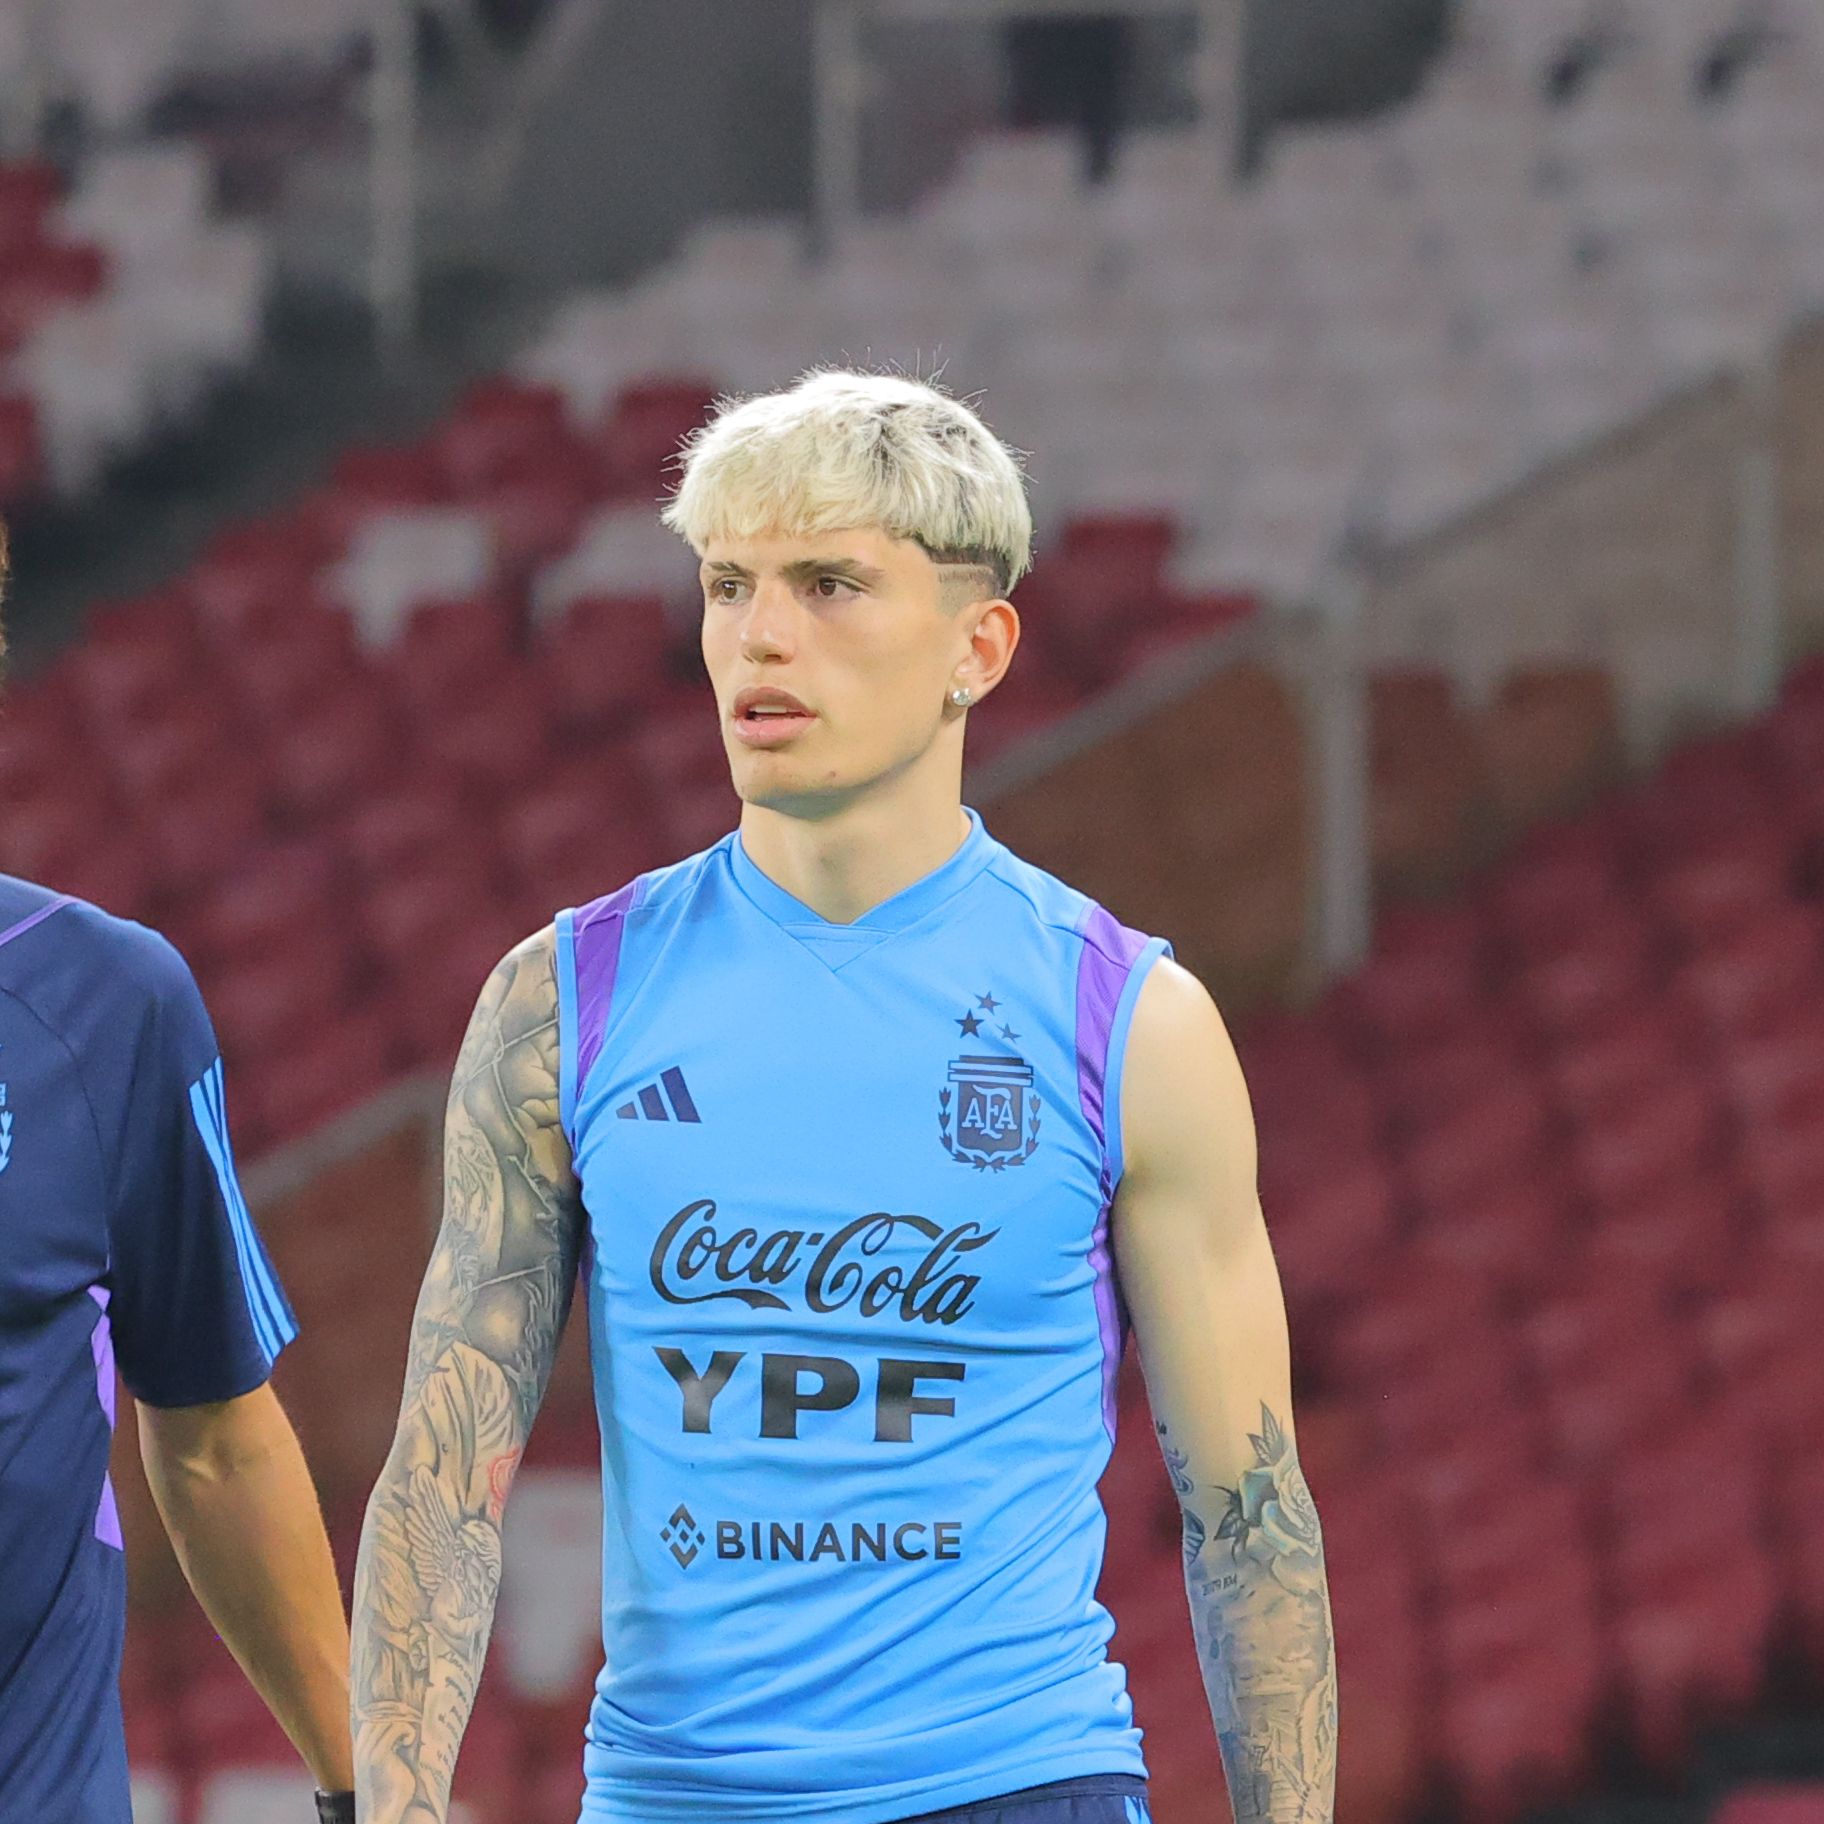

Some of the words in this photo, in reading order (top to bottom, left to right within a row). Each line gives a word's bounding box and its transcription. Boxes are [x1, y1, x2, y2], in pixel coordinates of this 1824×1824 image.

[961, 1083, 1019, 1141] AFA
[649, 1199, 1002, 1326] Coca-Cola
[652, 1345, 967, 1444] YPF
[716, 1519, 964, 1563] BINANCE
